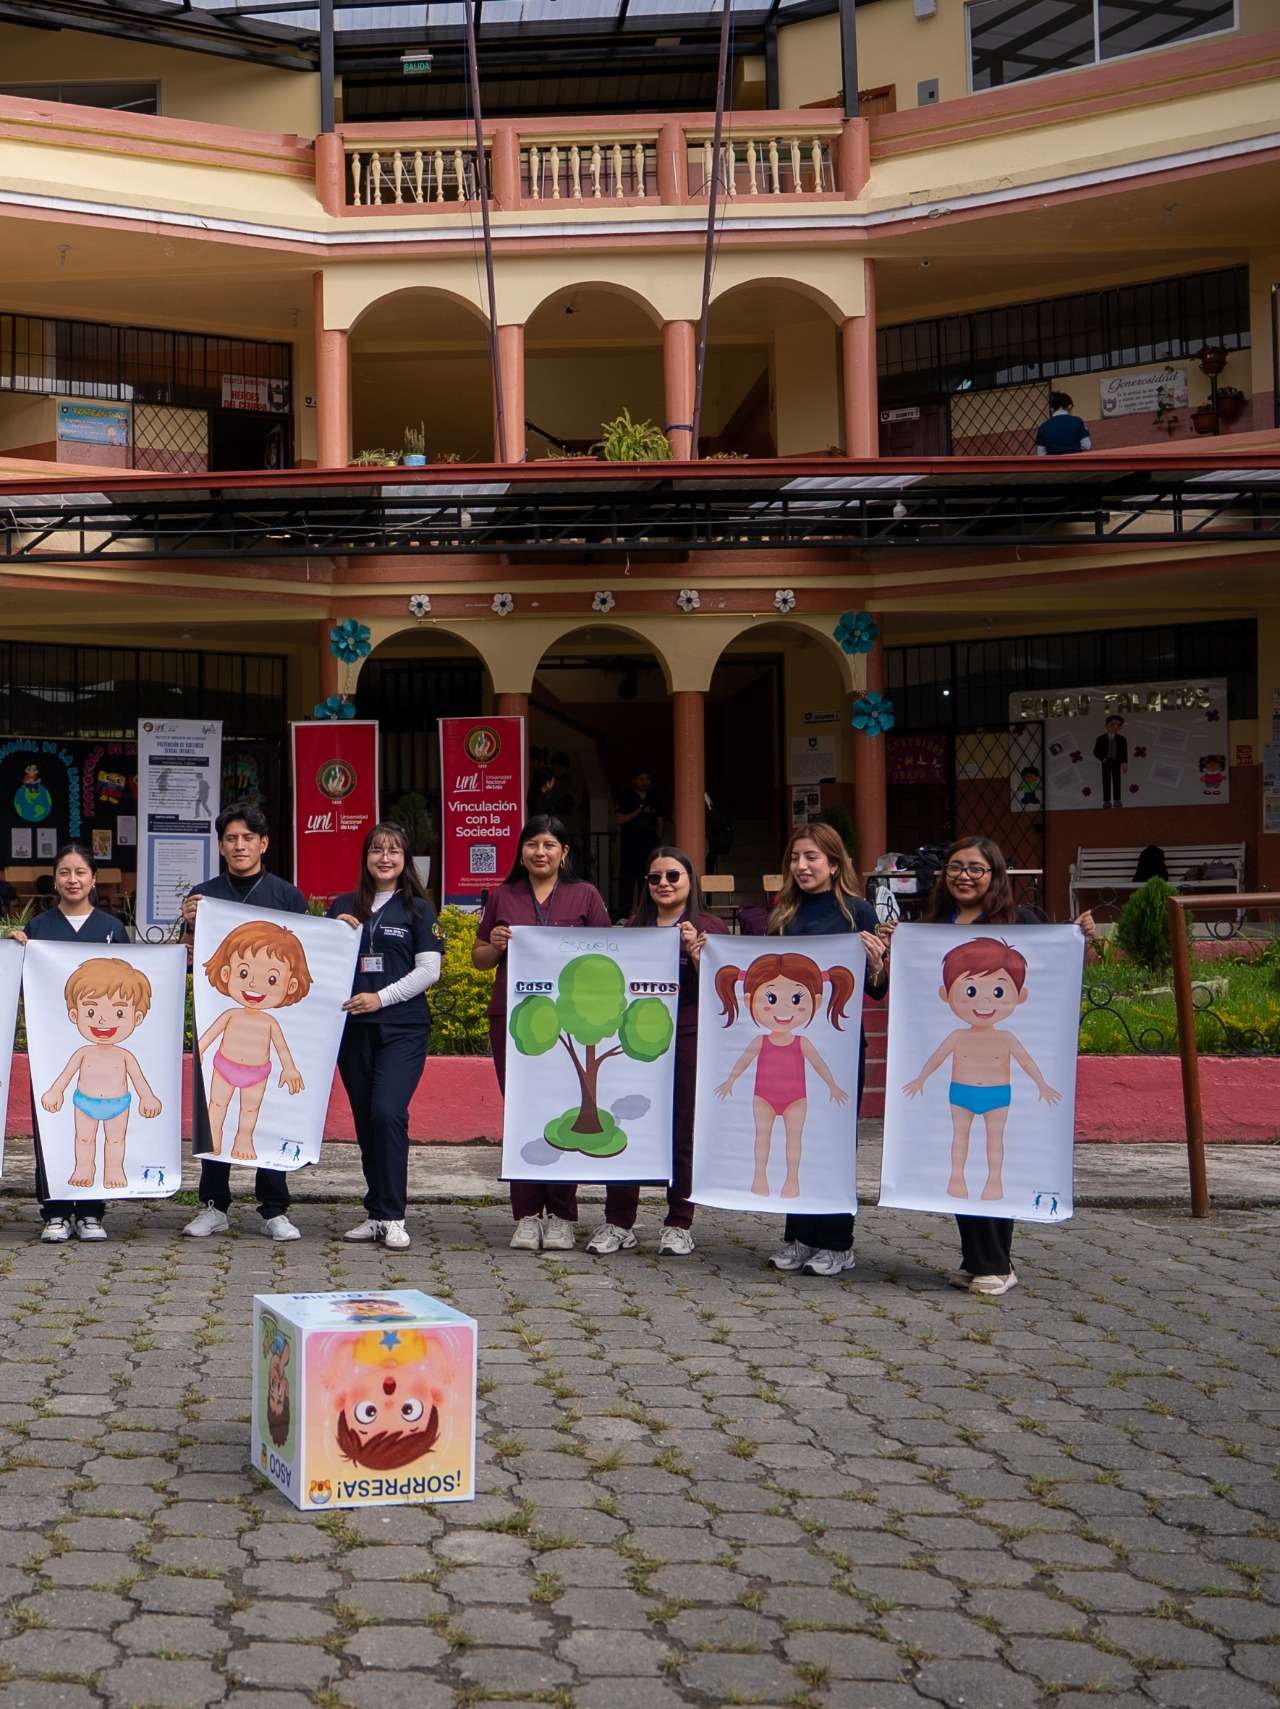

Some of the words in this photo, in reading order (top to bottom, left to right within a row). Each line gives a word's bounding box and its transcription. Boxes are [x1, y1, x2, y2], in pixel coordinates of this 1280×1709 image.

[448, 800, 517, 812] Vinculación
[465, 815, 487, 824] con
[490, 813, 500, 824] la
[455, 825, 510, 837] Sociedad
[291, 1292, 364, 1301] MIEDO
[270, 1454, 292, 1488] ASCO
[337, 1470, 461, 1498] ¡SORPRESA!
